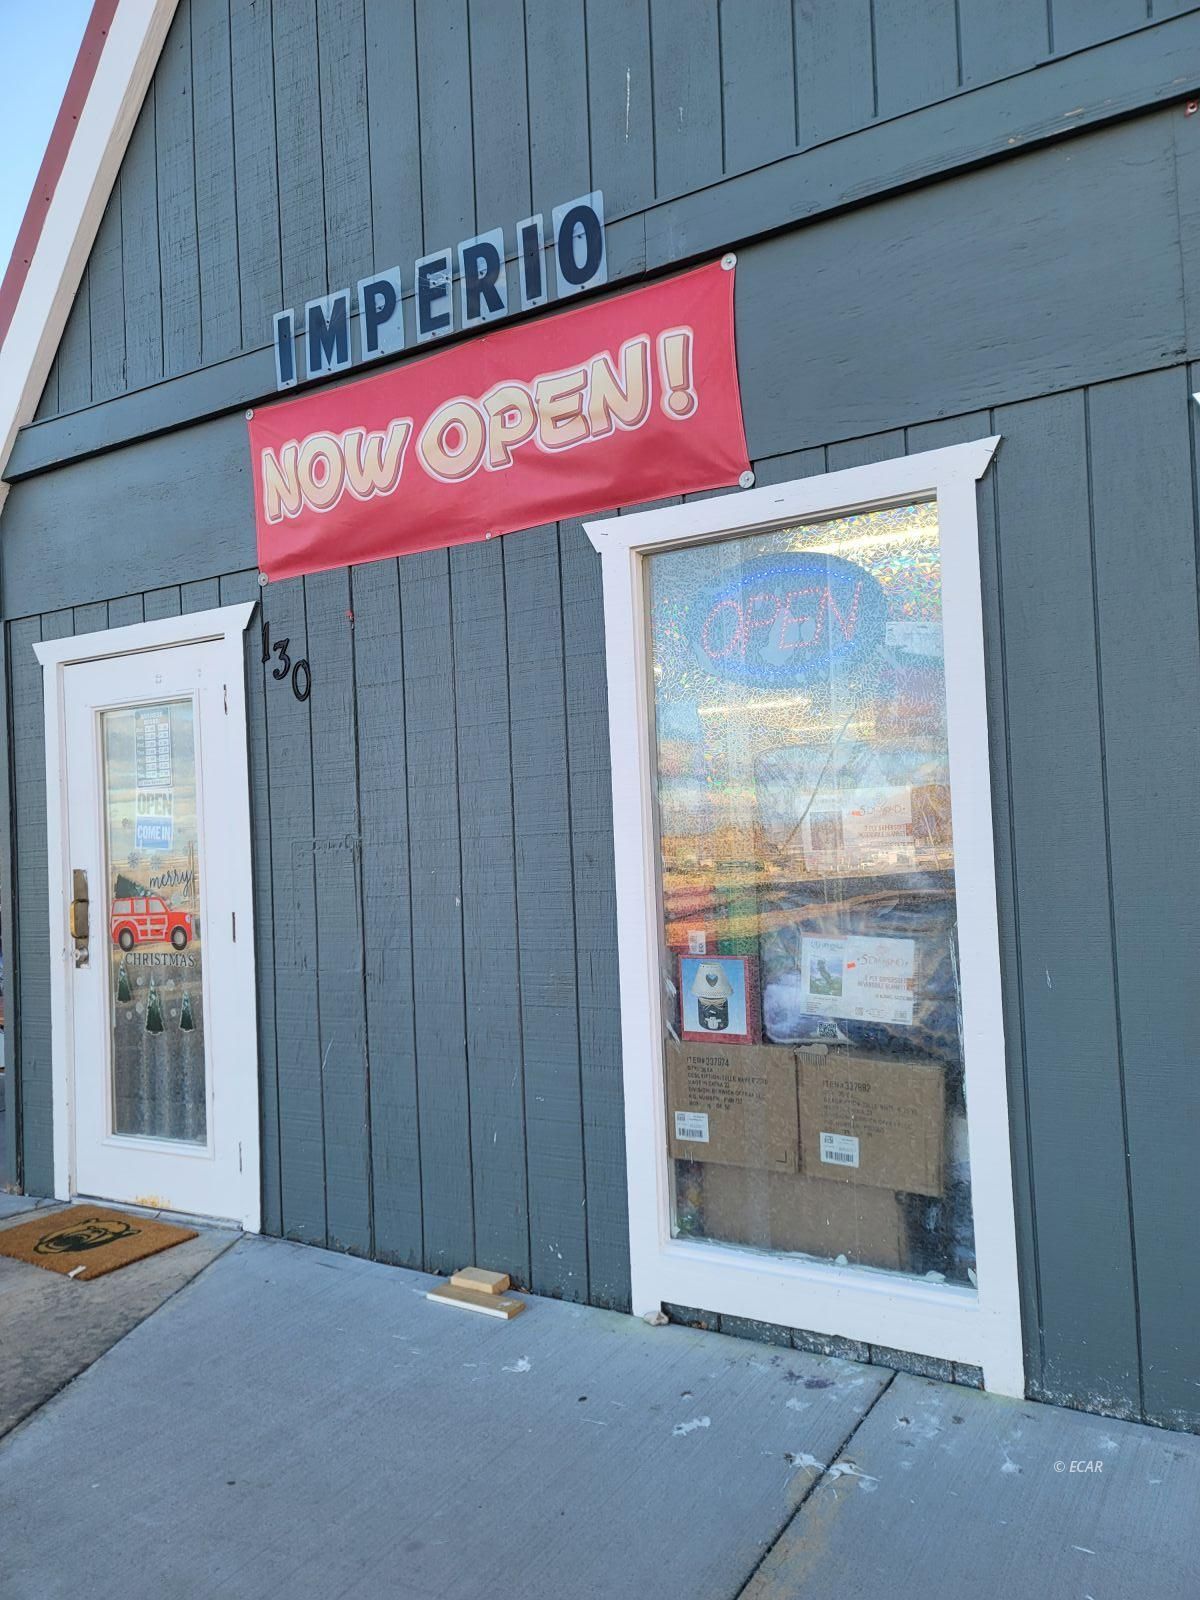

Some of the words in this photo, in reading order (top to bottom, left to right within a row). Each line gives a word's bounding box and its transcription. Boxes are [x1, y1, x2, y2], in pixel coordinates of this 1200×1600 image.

[278, 205, 601, 383] IMPERIO
[262, 416, 413, 524] NOW
[702, 580, 862, 660] OPEN
[261, 621, 312, 702] 130
[137, 793, 173, 816] OPEN
[137, 824, 161, 841] COME
[162, 825, 174, 841] IN
[150, 868, 195, 898] merry
[125, 952, 195, 968] CHRISTMAS
